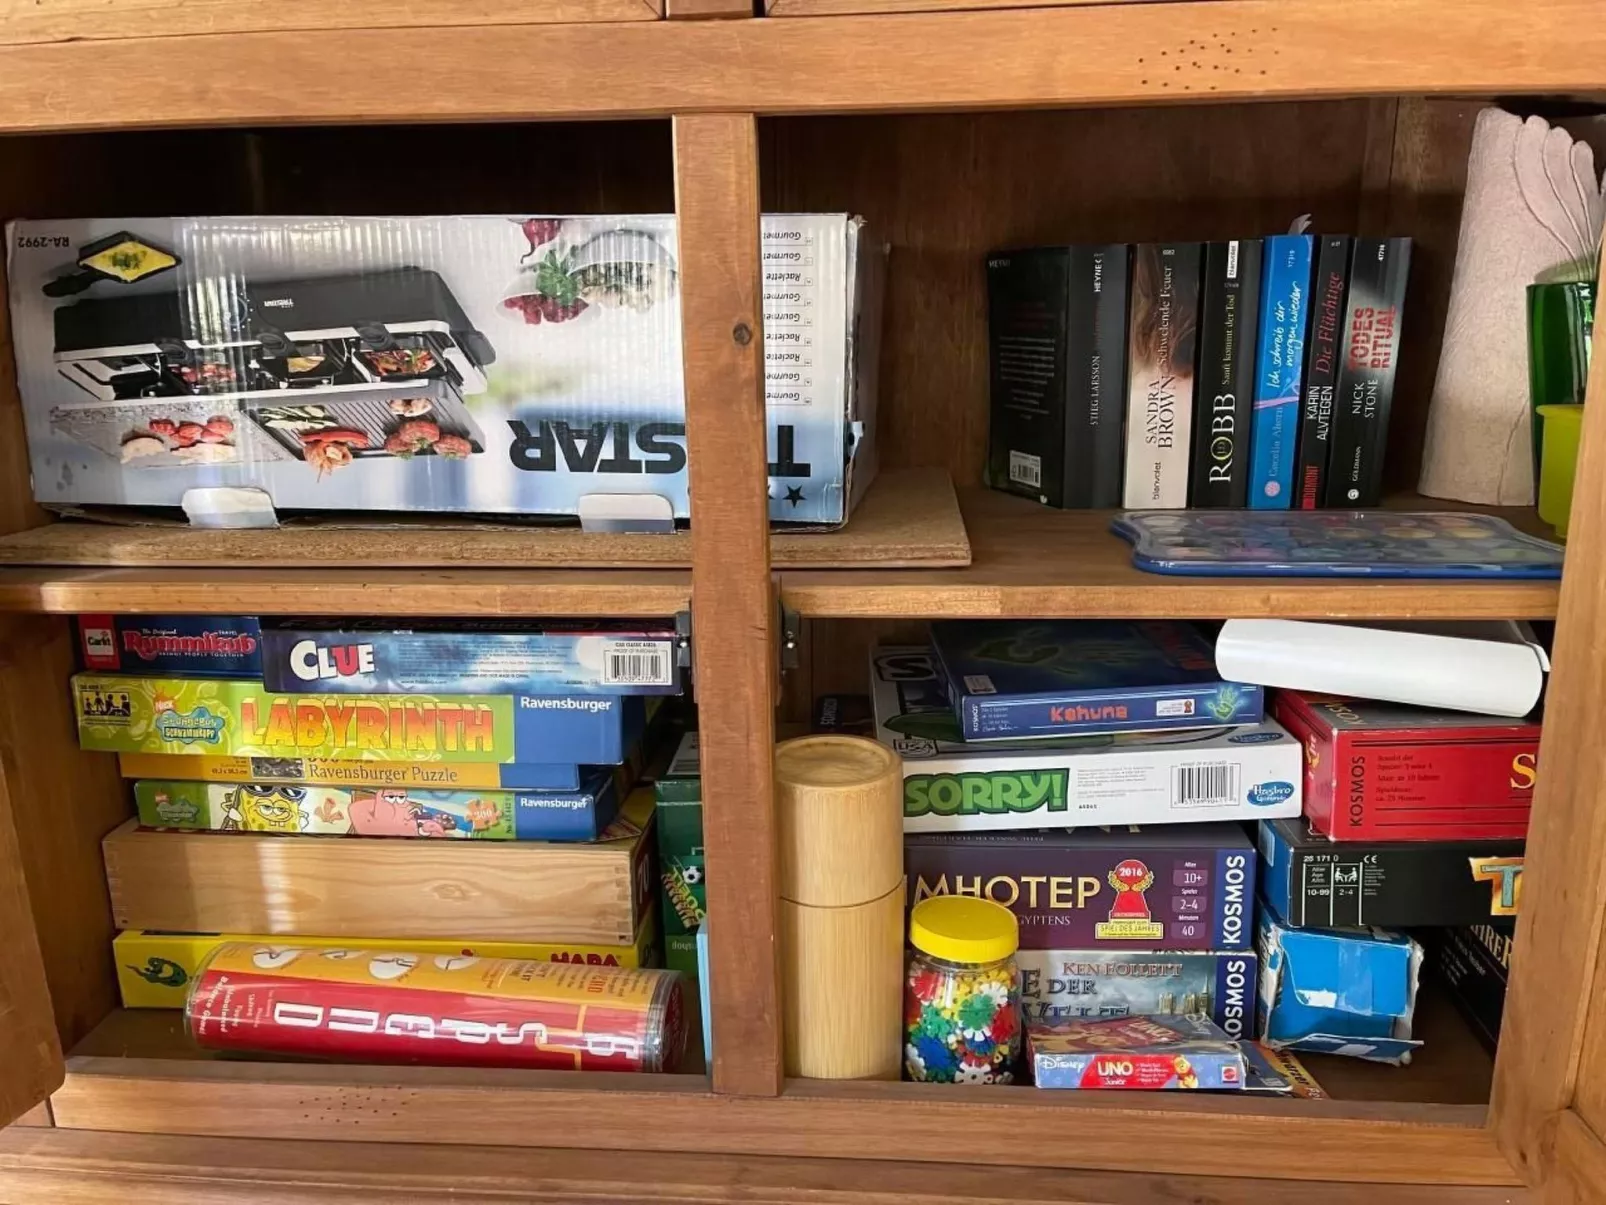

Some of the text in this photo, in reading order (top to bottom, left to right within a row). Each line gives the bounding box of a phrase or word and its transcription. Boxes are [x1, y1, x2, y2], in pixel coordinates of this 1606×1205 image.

[17, 236, 70, 248] RA-2992
[766, 272, 801, 282] Raclette
[1286, 281, 1303, 367] morgen wieder
[1315, 272, 1345, 375] Die Flüchtige
[1348, 307, 1375, 370] TODES
[1370, 304, 1396, 368] RITUAL
[1266, 300, 1286, 388] Ich schreib dir
[766, 392, 800, 402] Gourme
[1146, 380, 1160, 444] SANDRA
[1158, 375, 1176, 448] BROWN
[1306, 386, 1320, 420] KARIN
[1352, 383, 1365, 414] NICK
[1364, 379, 1378, 418] STONE
[1317, 386, 1333, 441] ALVTEGEN
[1208, 393, 1236, 483] ROBB
[123, 630, 257, 660] Rummikub
[290, 640, 375, 681] CLUE
[520, 697, 612, 712] Ravensburger
[241, 697, 494, 752] LABYRINTH
[309, 764, 458, 784] Ravensburger Puzzle
[520, 797, 588, 809] Ravensburger
[904, 770, 1067, 814] SORRY!
[1254, 784, 1291, 796] Hasbro
[1350, 756, 1365, 827] KOSMOS
[1118, 866, 1143, 877] 2016
[1184, 872, 1202, 884] 10+
[1181, 888, 1198, 896] Spieler
[1222, 855, 1246, 944] KOSMOS
[1118, 924, 1132, 932] DES
[1182, 926, 1194, 936] 40
[1063, 962, 1183, 978] KEN FOLLETT
[1049, 980, 1098, 995] DER
[1042, 1056, 1085, 1072] Disney
[1097, 1062, 1134, 1077] UNO
